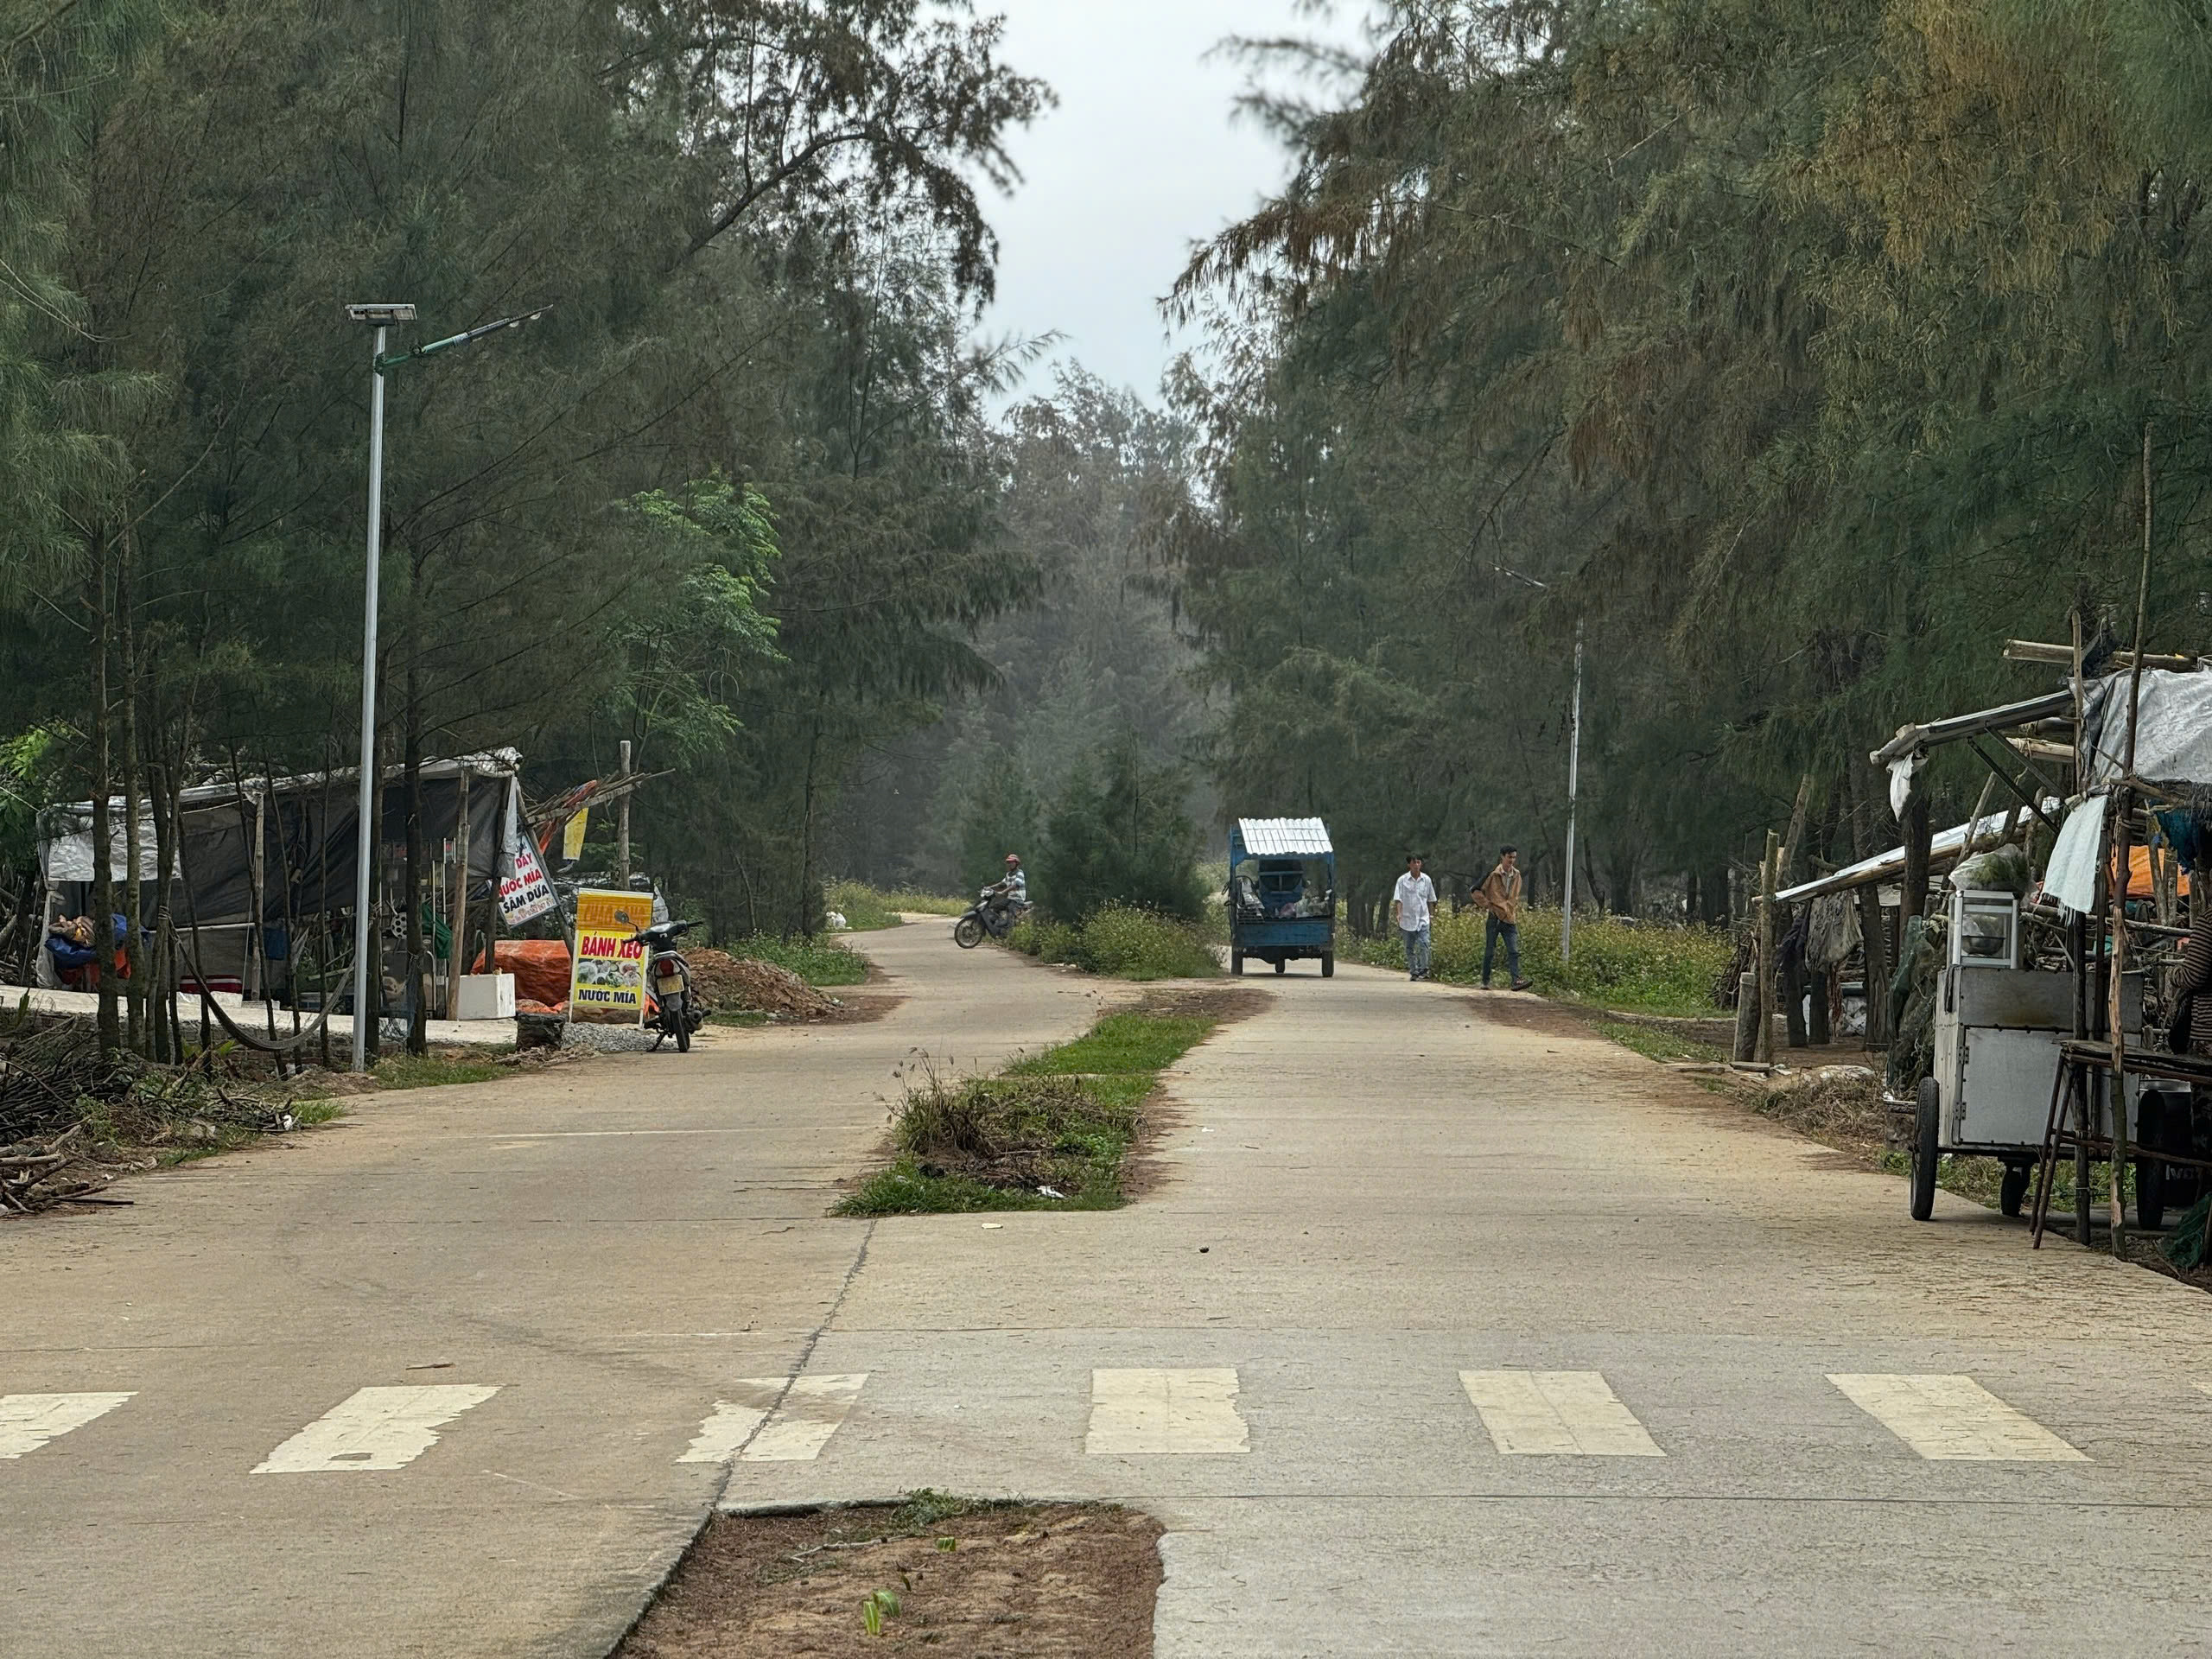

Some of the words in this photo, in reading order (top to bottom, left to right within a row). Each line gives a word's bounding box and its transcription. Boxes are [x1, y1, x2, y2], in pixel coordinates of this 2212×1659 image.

[524, 868, 543, 887] MÍA
[503, 895, 526, 914] SÂM
[581, 931, 616, 957] BÁNH
[578, 988, 610, 1002] NƯỚC
[613, 989, 637, 1004] MÍA
